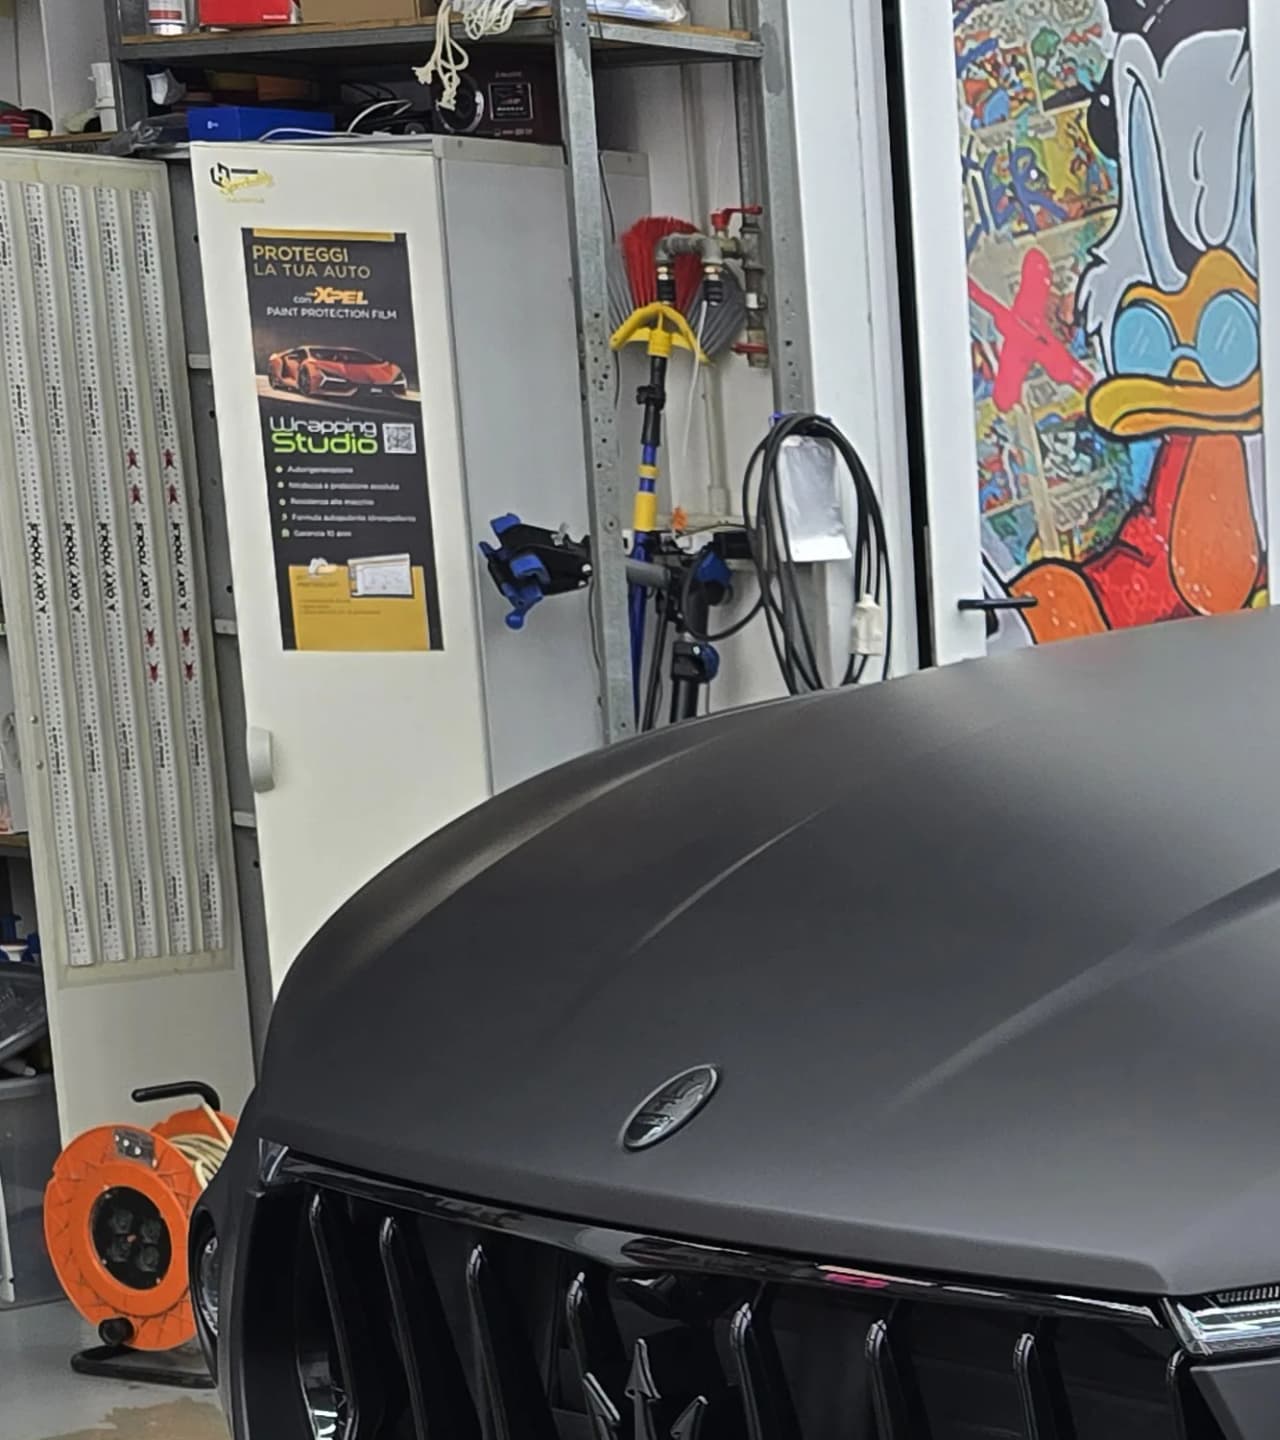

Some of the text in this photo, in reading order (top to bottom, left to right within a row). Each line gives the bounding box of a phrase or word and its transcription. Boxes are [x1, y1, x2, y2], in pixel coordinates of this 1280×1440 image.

[252, 244, 349, 263] PROTEGGI
[253, 263, 371, 279] LA TUA AUTO
[293, 286, 369, 305] con XPEL
[266, 306, 398, 320] PAINT PROTECTION FILM
[269, 416, 377, 437] Wrapping
[271, 432, 378, 454] Studio
